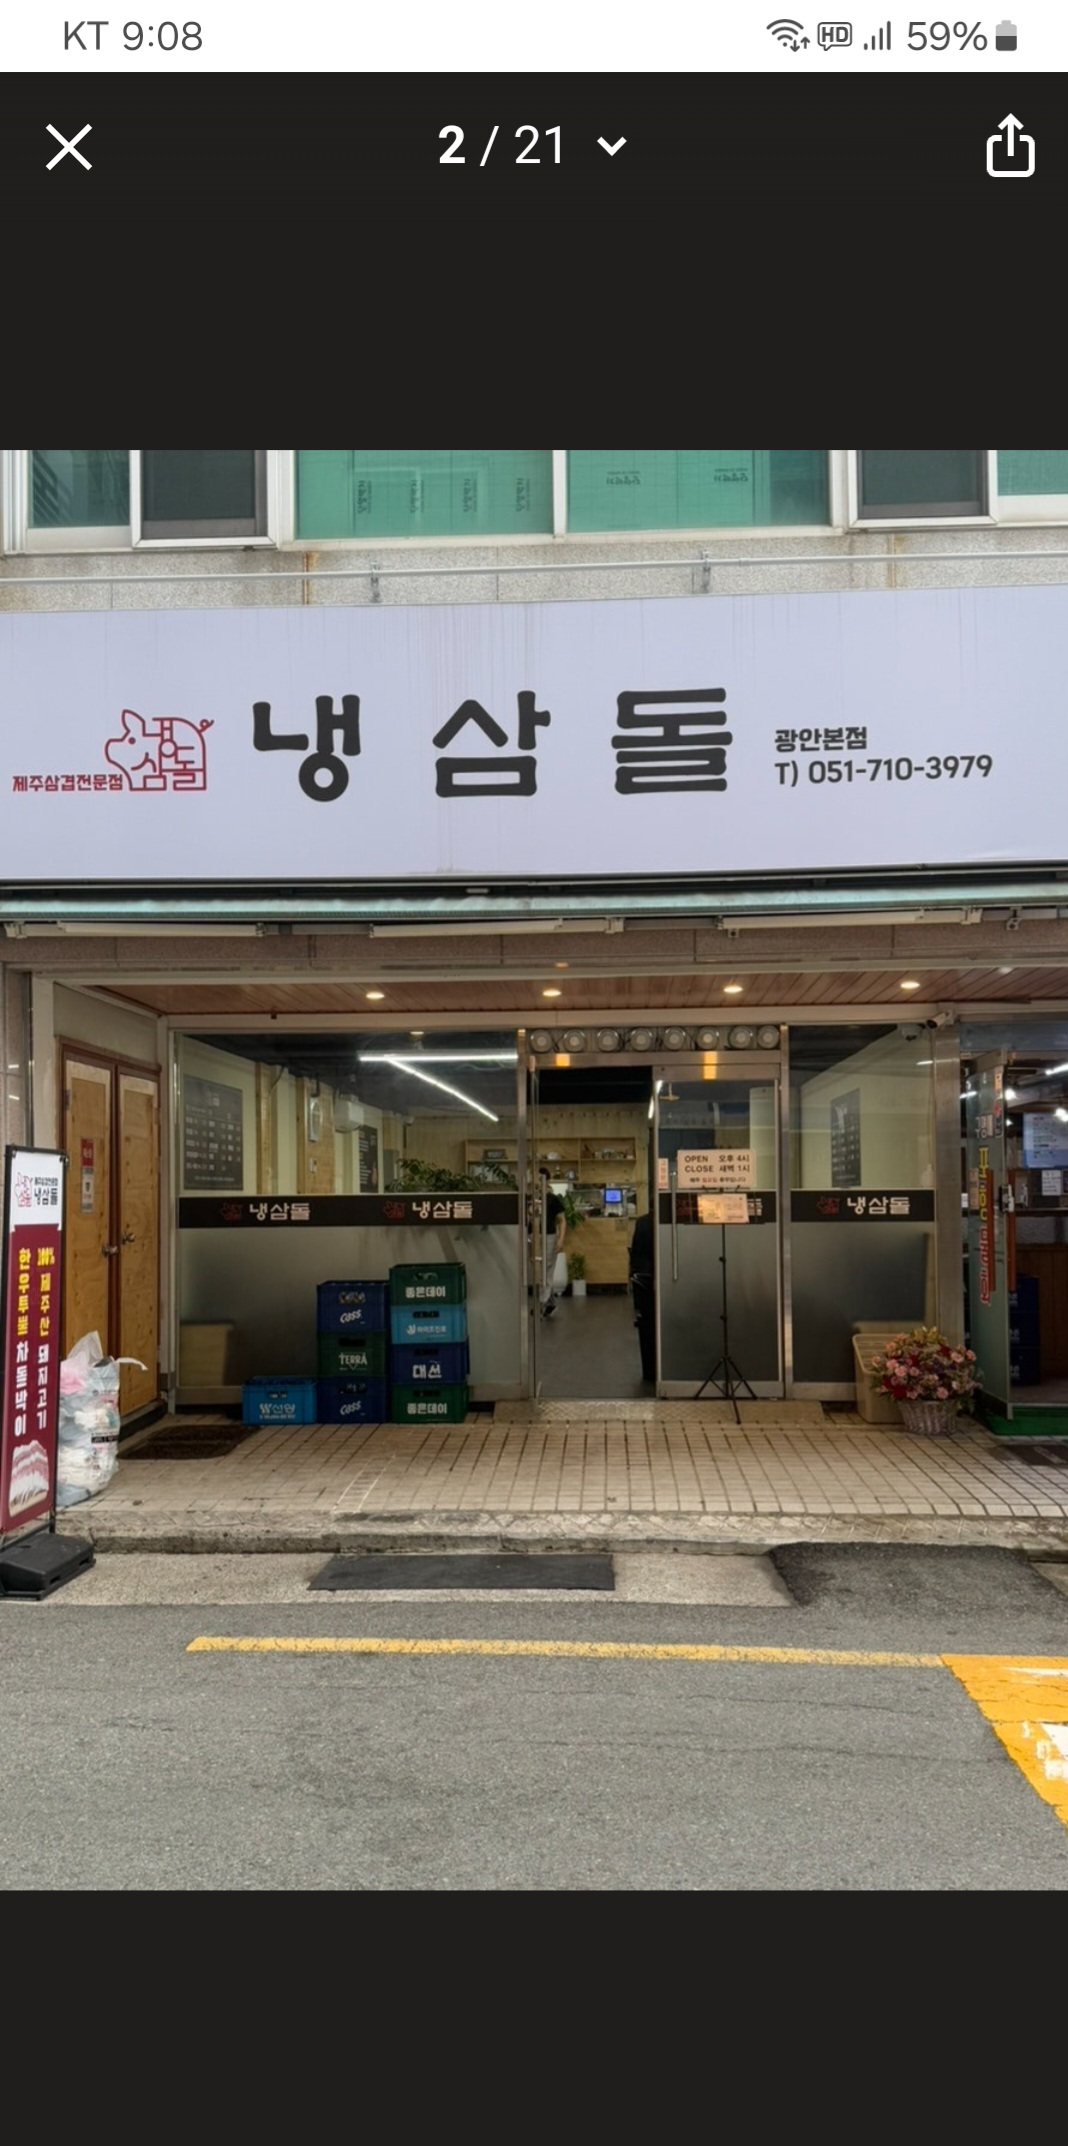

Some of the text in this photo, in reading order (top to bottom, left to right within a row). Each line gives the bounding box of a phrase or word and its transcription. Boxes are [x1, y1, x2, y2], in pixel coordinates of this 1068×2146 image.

[774, 726, 868, 753] 광안본점
[774, 754, 993, 788] T) 051-710-3979
[12, 774, 123, 792] 제주삼겹전문점
[684, 1154, 750, 1163] OPEN 오후 4시
[684, 1164, 750, 1173] CLOSE 새벽 1시
[249, 1202, 311, 1221] 냉삼돌
[412, 1200, 473, 1219] 냉삼돌
[847, 1196, 911, 1215] 냉삼돌
[405, 1286, 446, 1298] 좋은데이
[39, 1272, 51, 1337] 제주산
[338, 1352, 368, 1366] TERRA
[412, 1362, 442, 1379] 대선
[14, 1341, 29, 1437] 차돌박이
[37, 1343, 50, 1430] 돼지고기
[406, 1402, 448, 1415] 좋은데이
